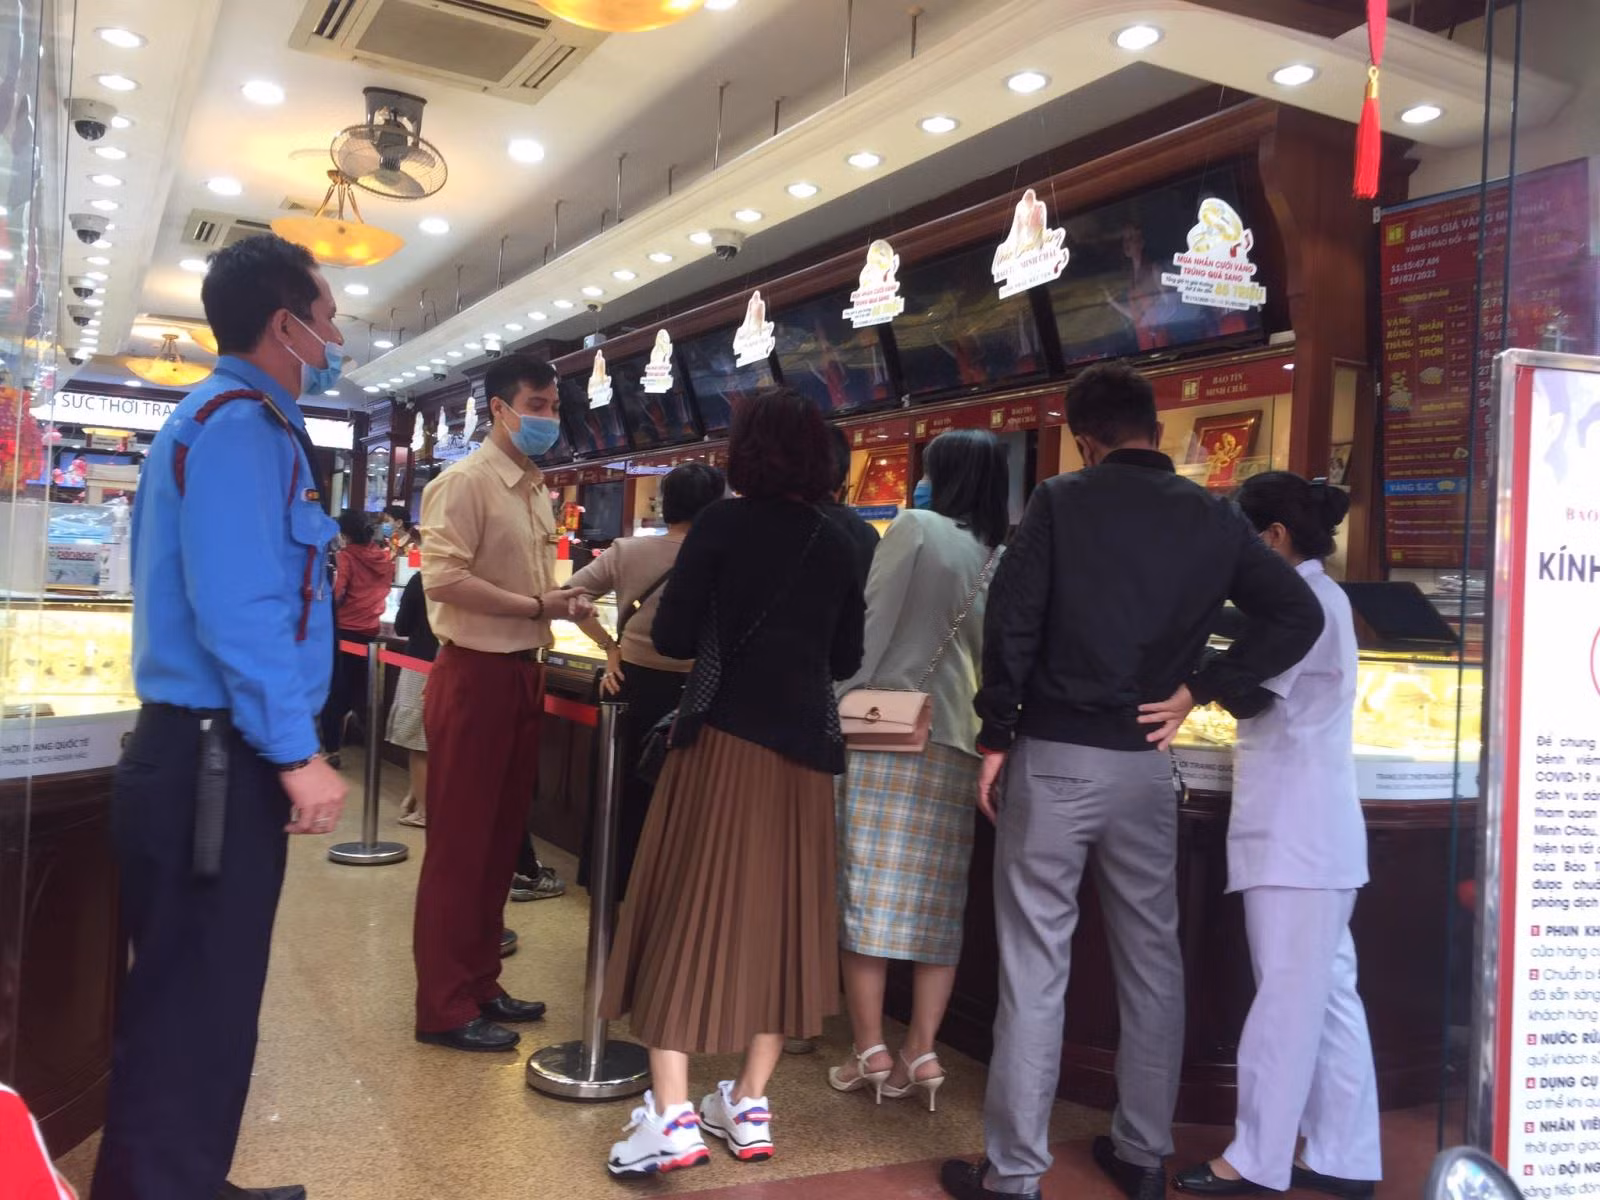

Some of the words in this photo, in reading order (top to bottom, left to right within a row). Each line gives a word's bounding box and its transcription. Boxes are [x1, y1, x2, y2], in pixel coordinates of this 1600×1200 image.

[1461, 212, 1493, 229] VÀG
[1560, 738, 1596, 751] chung
[1536, 771, 1592, 783] COVID-19
[1535, 807, 1564, 818] tham
[1568, 810, 1597, 821] quan
[1534, 824, 1562, 835] Minh
[1532, 896, 1570, 912] phòng
[1545, 925, 1579, 936] PHUN
[1529, 1008, 1565, 1021] khách
[1552, 1053, 1587, 1065] khách
[1540, 1076, 1576, 1092] DỤNG
[1580, 1076, 1598, 1090] CỤ
[1540, 1117, 1575, 1132] NHÂN
[1549, 1142, 1575, 1156] gian
[1558, 1160, 1581, 1178] ĐỘI
